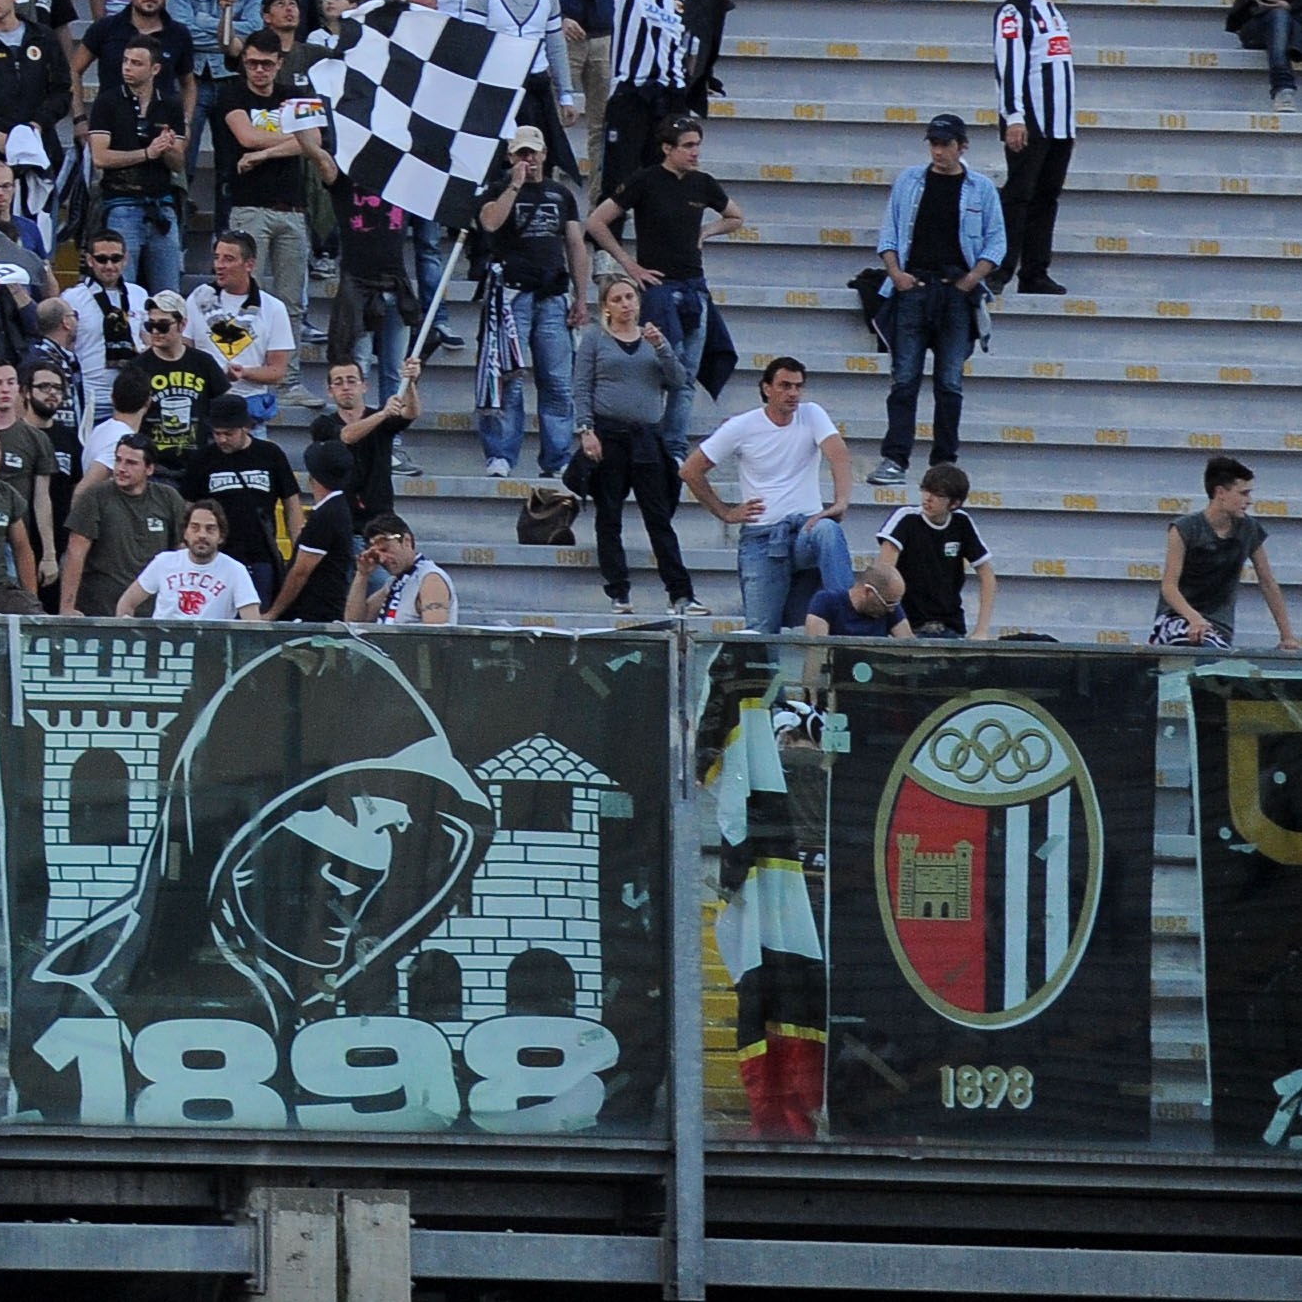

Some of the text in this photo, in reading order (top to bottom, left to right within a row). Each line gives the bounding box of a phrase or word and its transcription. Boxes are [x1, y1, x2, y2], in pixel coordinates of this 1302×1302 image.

[166, 571, 227, 598] FITCH
[31, 1014, 622, 1134] 1898
[939, 1064, 1036, 1111] 1898
